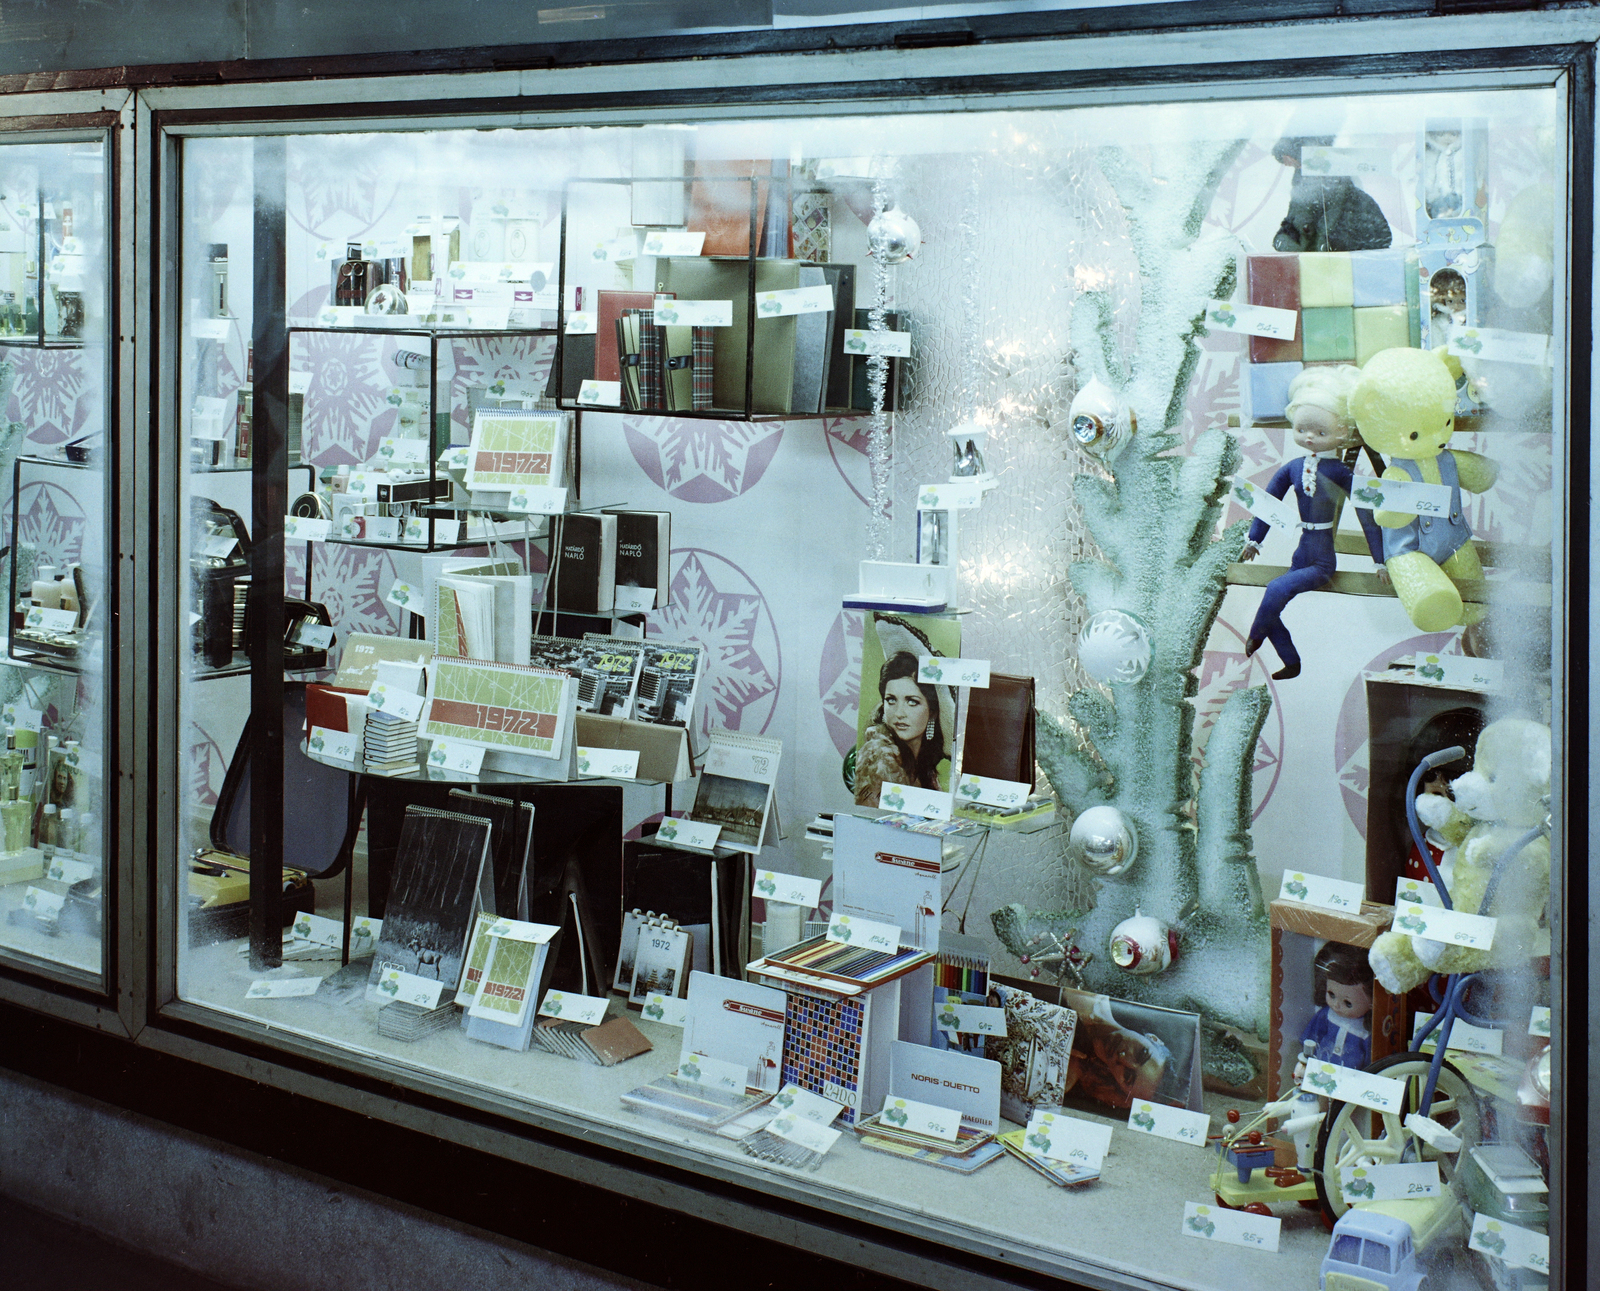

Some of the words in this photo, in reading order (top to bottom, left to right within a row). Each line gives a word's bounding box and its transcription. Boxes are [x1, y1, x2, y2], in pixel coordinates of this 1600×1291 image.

[493, 452, 548, 474] 1972
[355, 644, 375, 654] 1972
[597, 654, 633, 673] 1972
[659, 652, 695, 671] 1972
[477, 704, 539, 737] 1972
[652, 939, 671, 951] 1972
[490, 983, 523, 1001] 1972
